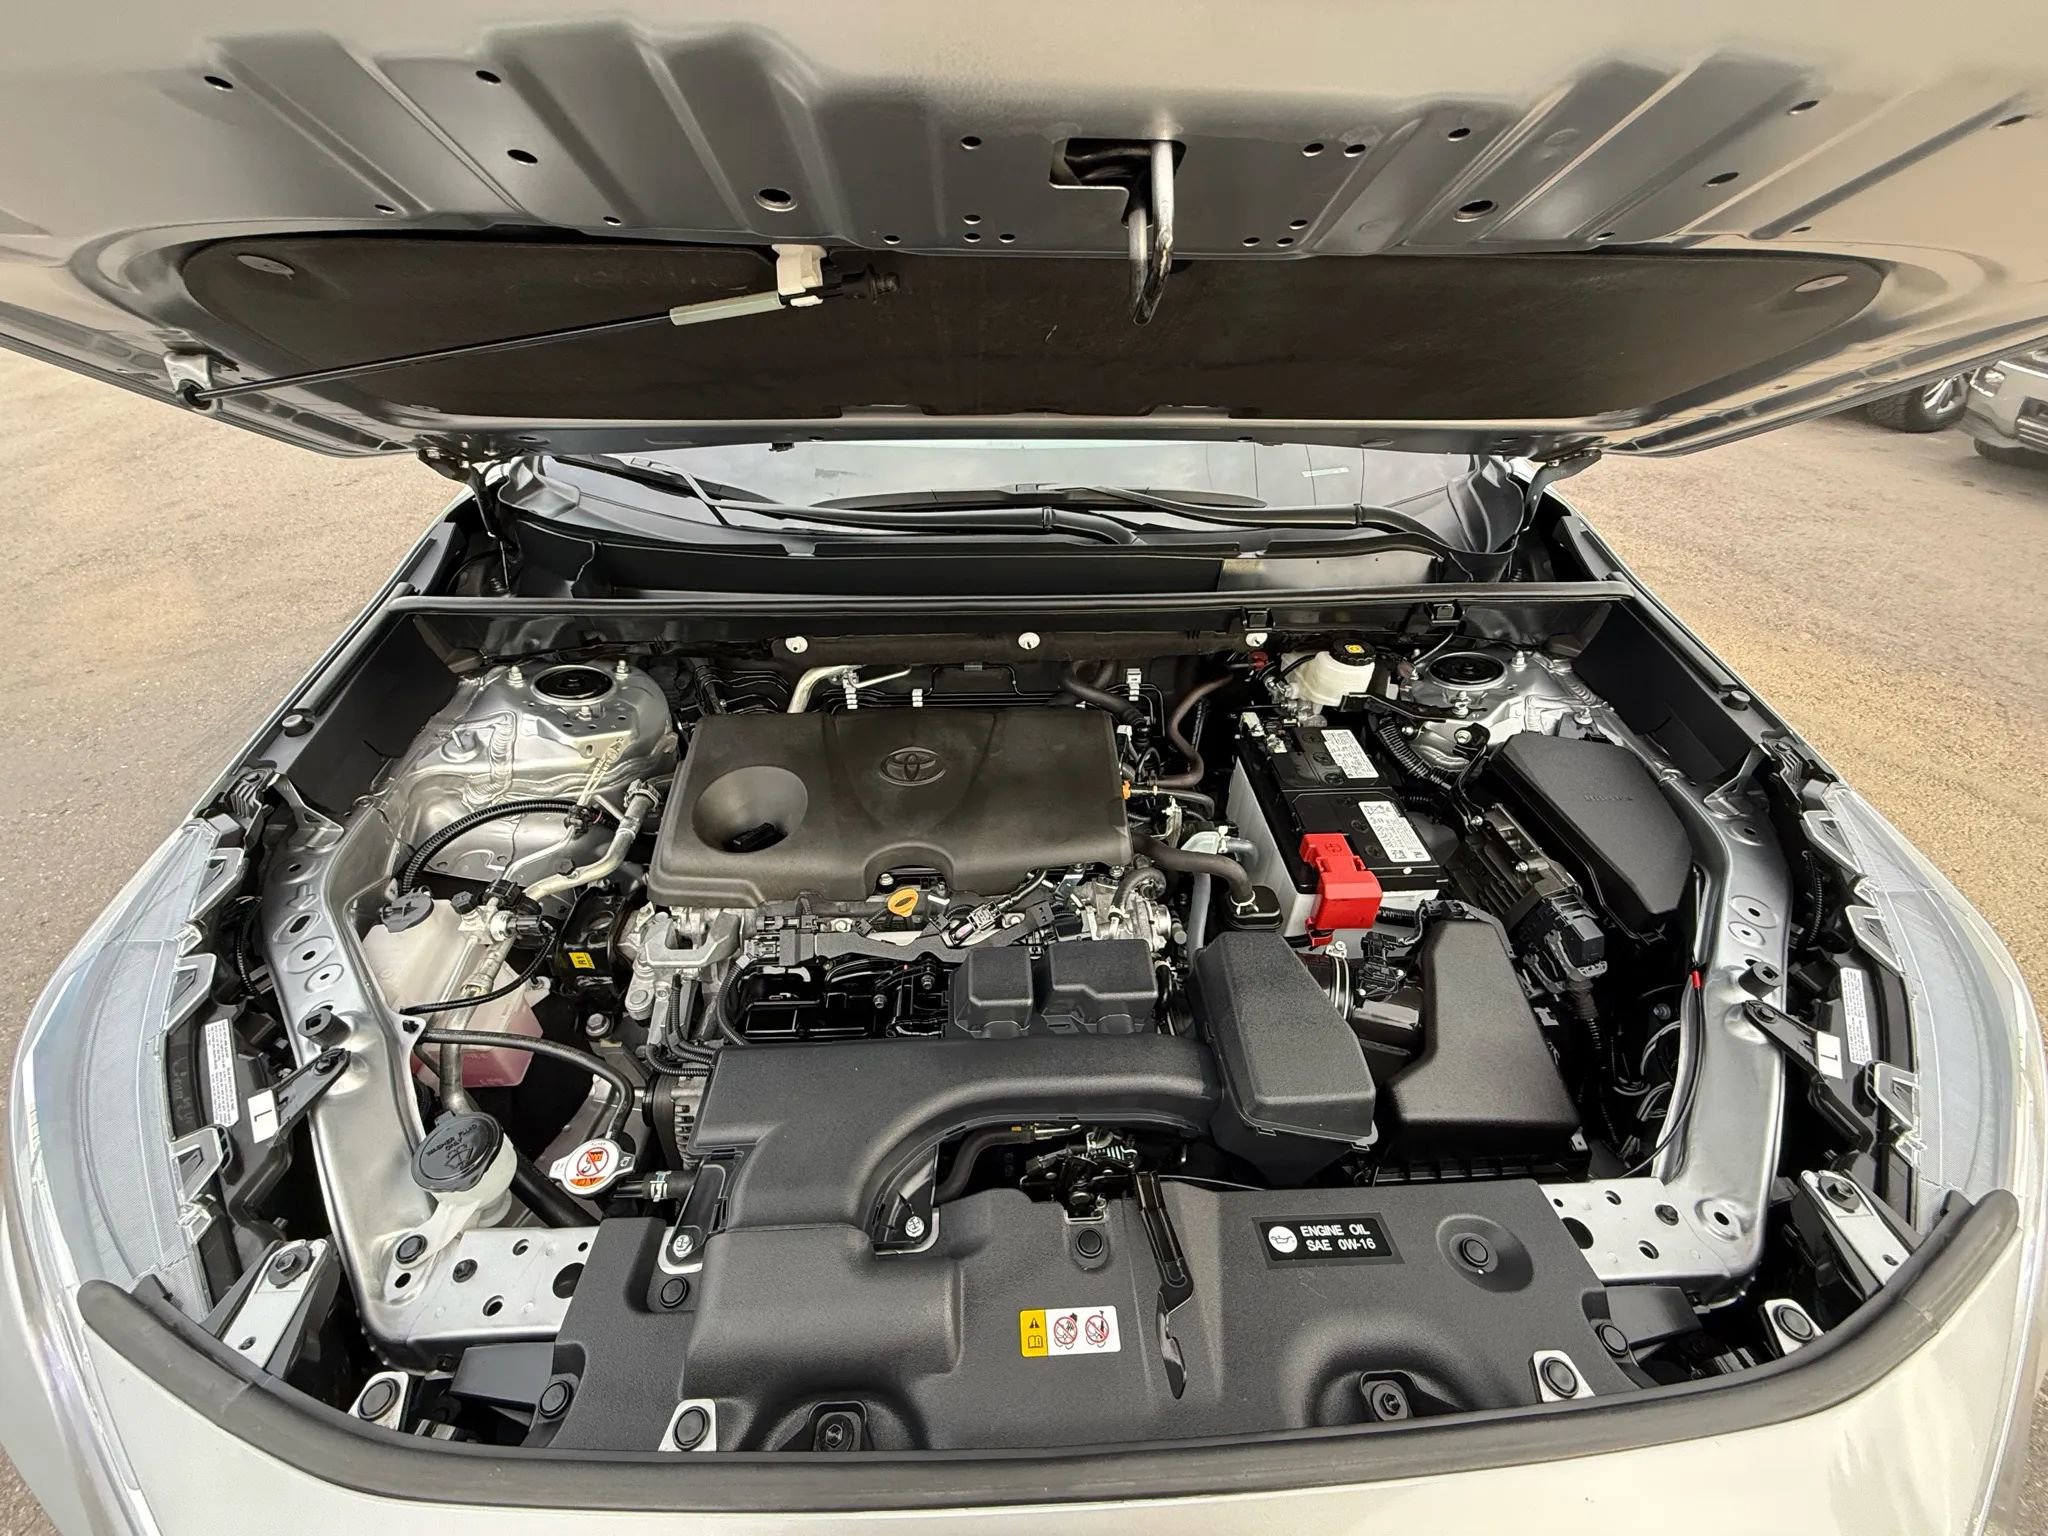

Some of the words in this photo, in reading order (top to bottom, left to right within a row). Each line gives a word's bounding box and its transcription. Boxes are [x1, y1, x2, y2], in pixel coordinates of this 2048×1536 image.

[1300, 1224, 1344, 1237] ENGINE
[1349, 1223, 1370, 1236] OIL
[1306, 1239, 1332, 1252] SAE
[1337, 1237, 1376, 1251] 0W-16
